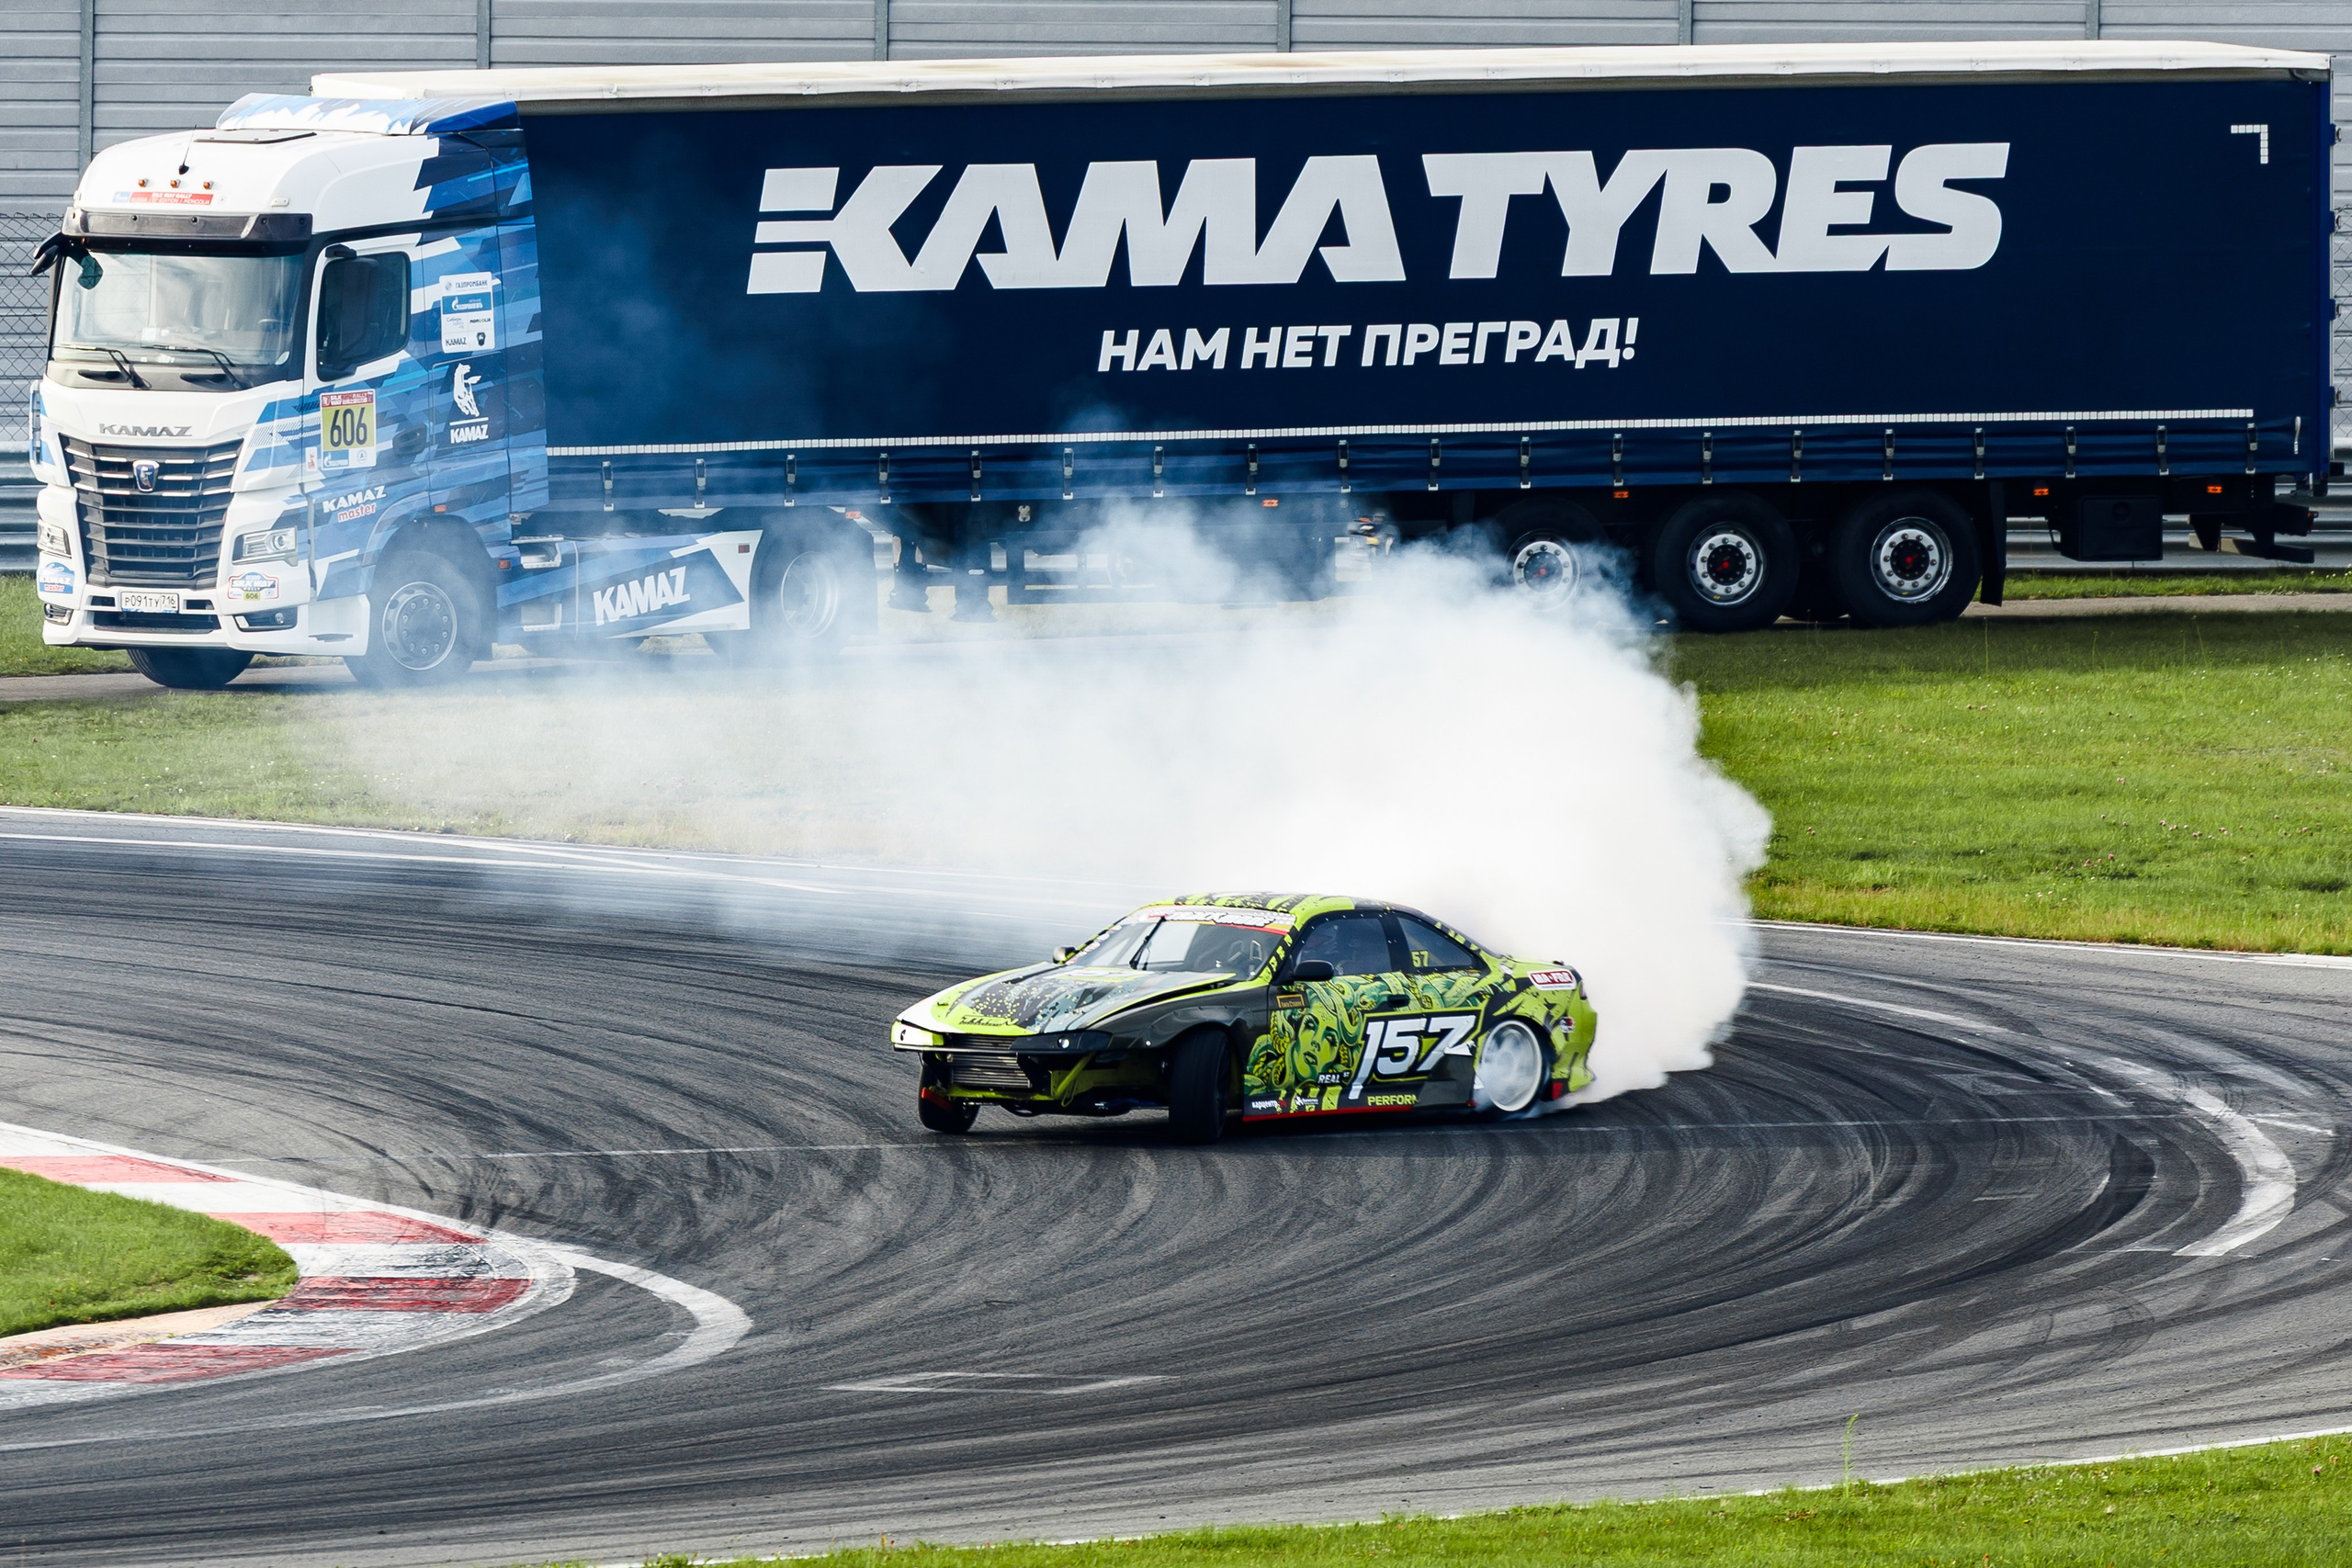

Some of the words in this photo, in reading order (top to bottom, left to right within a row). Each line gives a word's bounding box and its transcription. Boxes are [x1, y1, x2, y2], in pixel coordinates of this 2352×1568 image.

[746, 153, 1406, 295] KAMA
[1422, 141, 2010, 279] TYRES
[446, 337, 468, 346] KAMAZ
[1098, 327, 1230, 372] НАМ
[1240, 324, 1352, 369] НЕТ
[1361, 317, 1640, 369] ПРЕГРАД!
[99, 423, 192, 436] KAMAZ
[330, 407, 368, 447] 606
[449, 424, 489, 444] KAMAZ
[322, 485, 387, 513] KAMAZ
[337, 502, 377, 523] master
[593, 566, 691, 626] KAMAZ
[1348, 1014, 1477, 1100] 157
[1317, 1074, 1341, 1084] REAL
